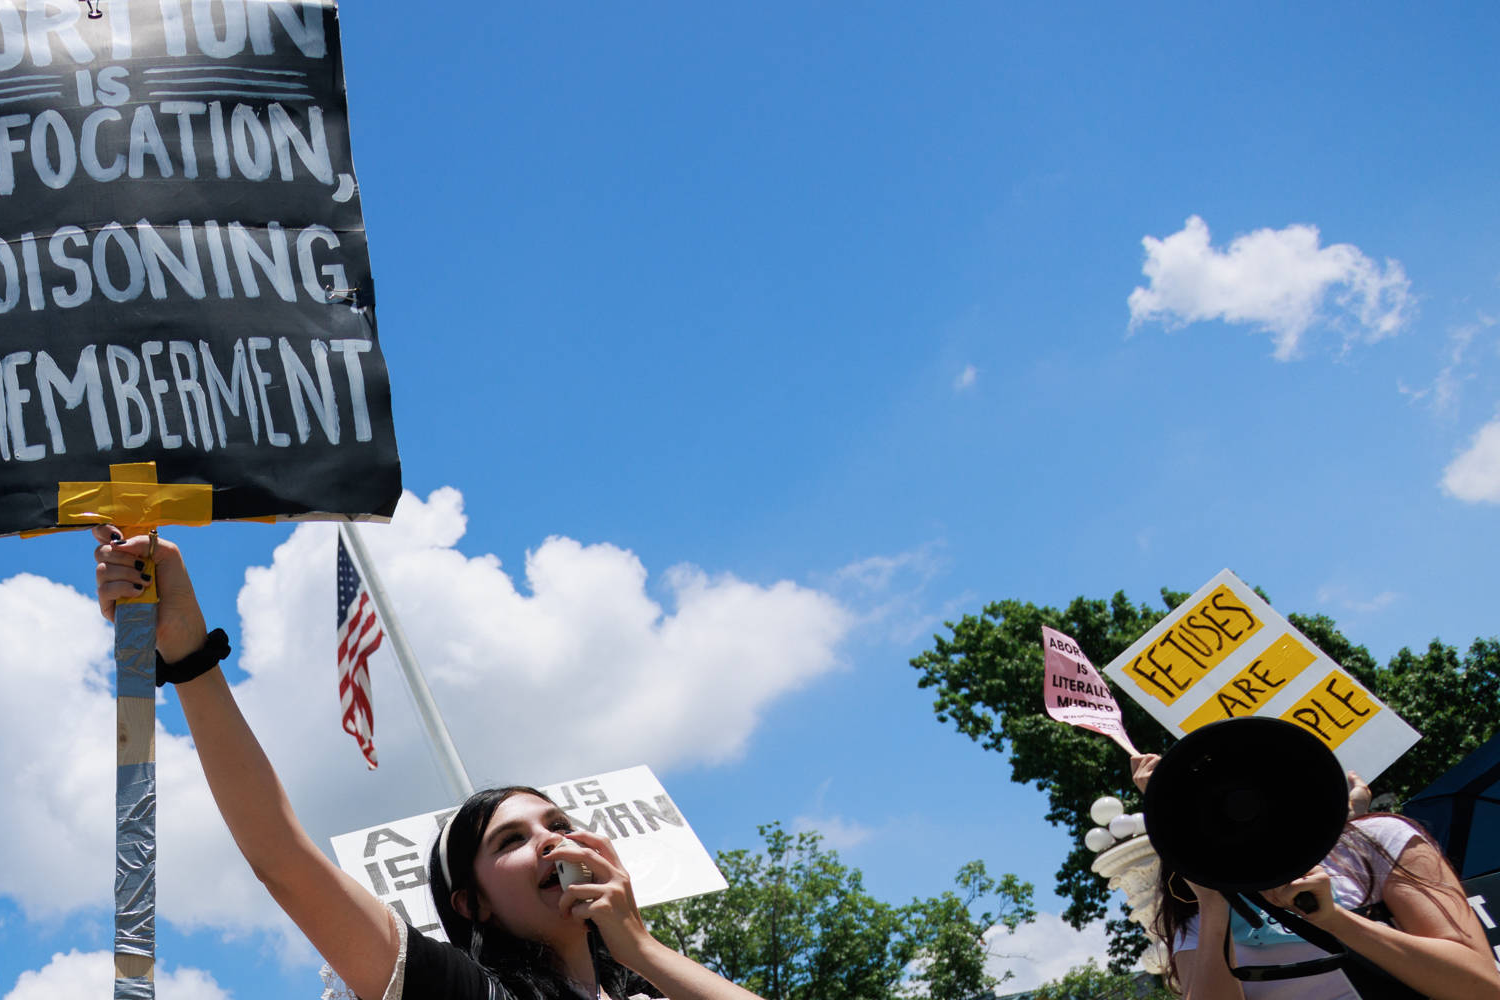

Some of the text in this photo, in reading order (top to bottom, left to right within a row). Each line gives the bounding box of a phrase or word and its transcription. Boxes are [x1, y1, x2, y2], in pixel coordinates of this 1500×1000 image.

[75, 66, 131, 108] IS
[1049, 637, 1082, 658] ABOR
[1132, 593, 1255, 698] FETUSES
[1052, 674, 1113, 700] LITERALLY
[1076, 662, 1088, 675] IS
[1217, 659, 1286, 717] ARE
[1292, 678, 1371, 741] PLE
[363, 827, 418, 858] A
[363, 851, 430, 896] IS
